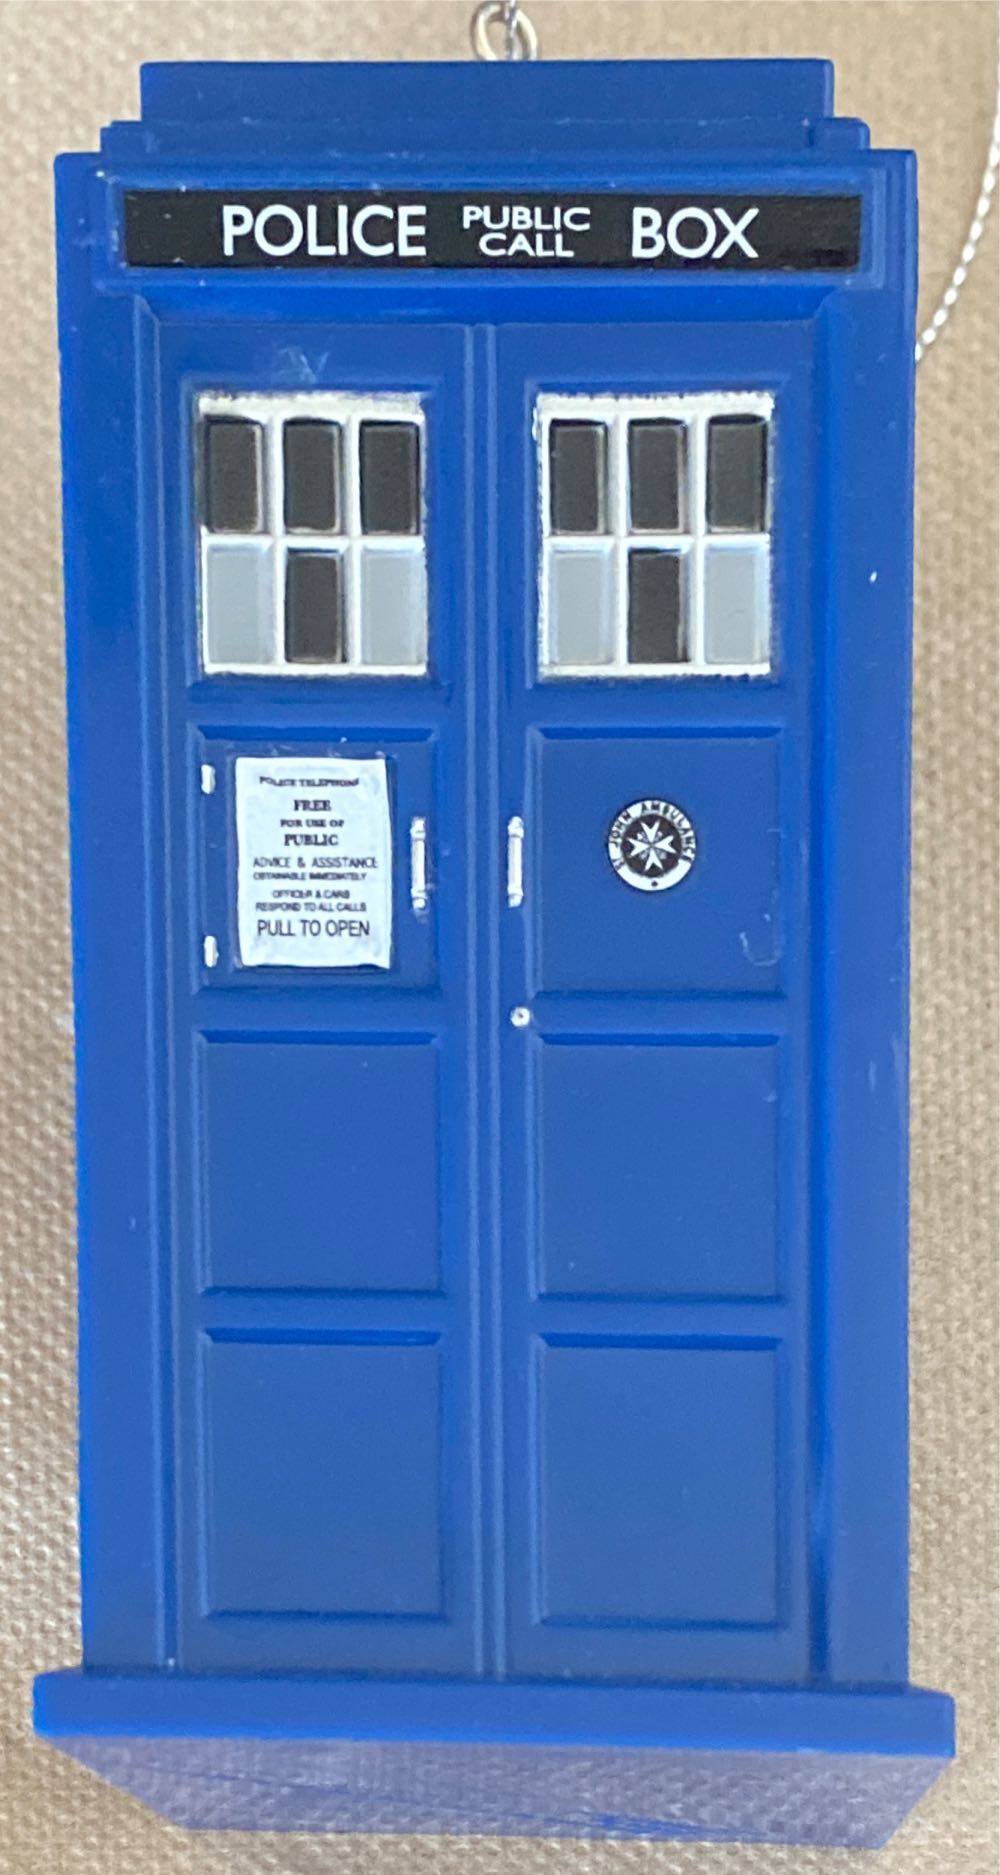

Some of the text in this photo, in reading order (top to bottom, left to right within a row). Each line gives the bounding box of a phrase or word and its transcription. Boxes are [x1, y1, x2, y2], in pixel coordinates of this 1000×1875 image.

[462, 206, 590, 231] PUBLIC
[222, 205, 427, 257] POLICE
[631, 207, 759, 259] BOX
[478, 233, 574, 257] CALL
[259, 776, 297, 787] POLICE
[294, 799, 332, 811] FREE
[280, 819, 344, 828] FOR USE OF
[284, 834, 338, 846] PUBLIC
[253, 857, 378, 868] ADVICE & ASSISTANCE
[255, 902, 366, 912] RESPOND TO ALL CALLS
[257, 919, 370, 937] PULL TO OPEN
